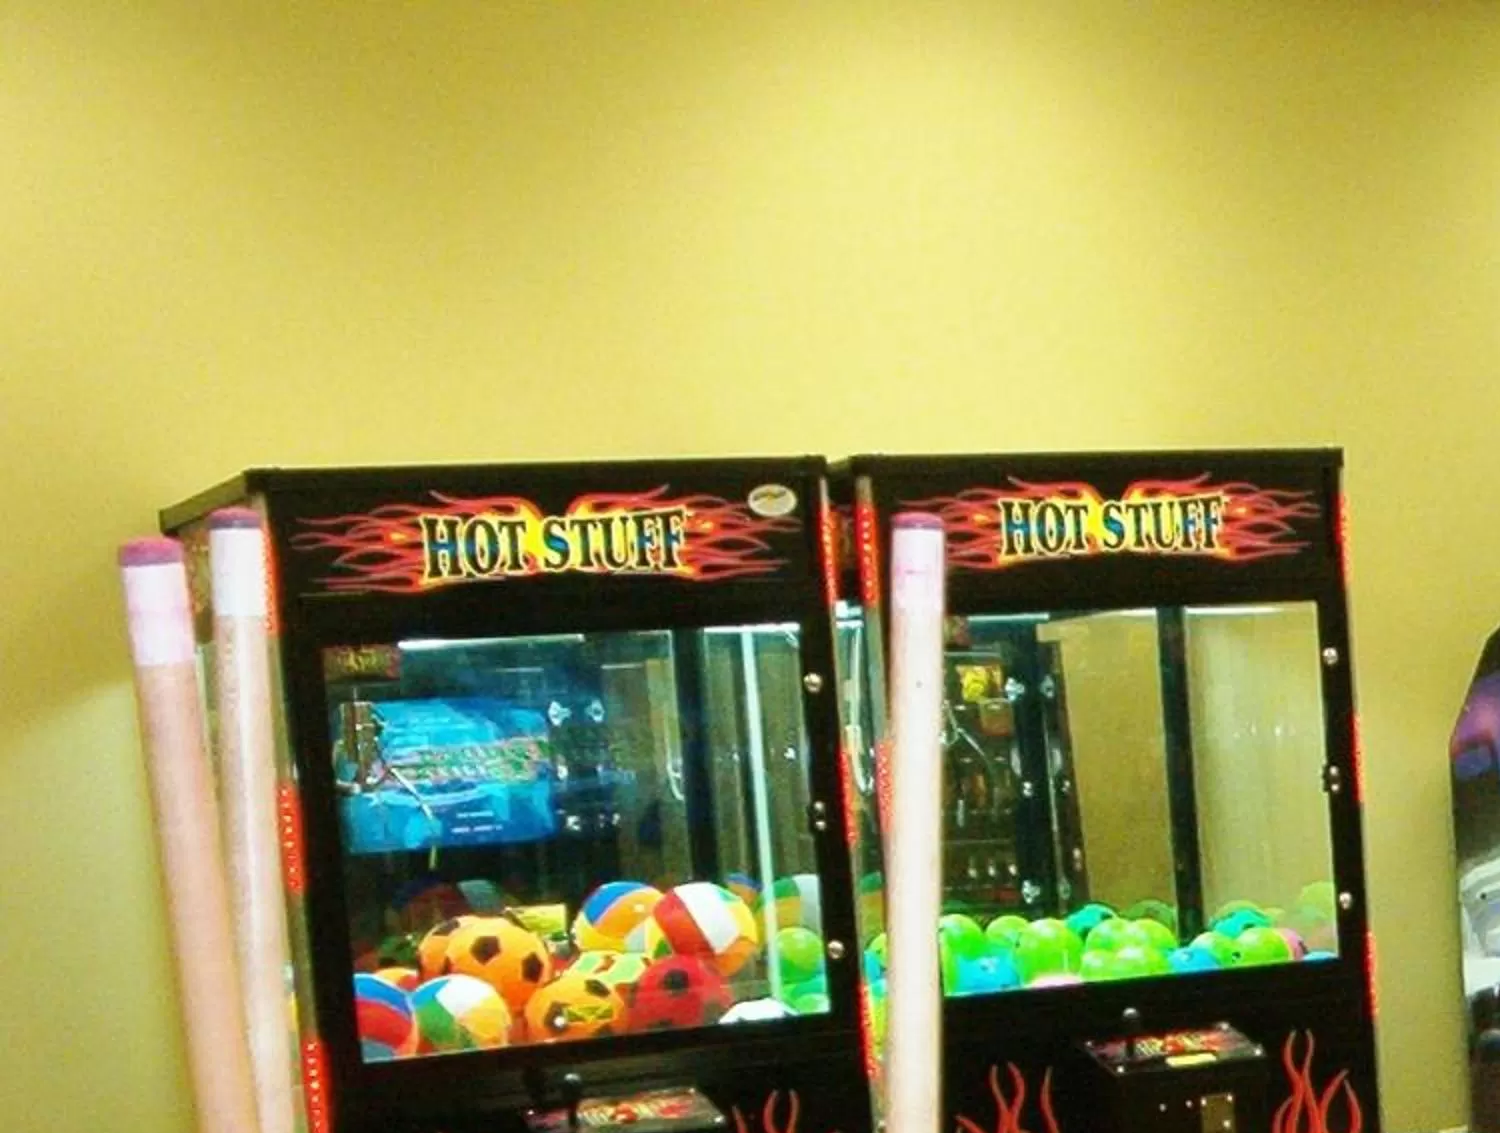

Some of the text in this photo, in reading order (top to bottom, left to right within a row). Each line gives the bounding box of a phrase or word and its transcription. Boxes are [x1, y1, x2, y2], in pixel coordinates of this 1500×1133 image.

[421, 508, 687, 578] HOT STUFF
[999, 496, 1223, 556] HOT STUFF
